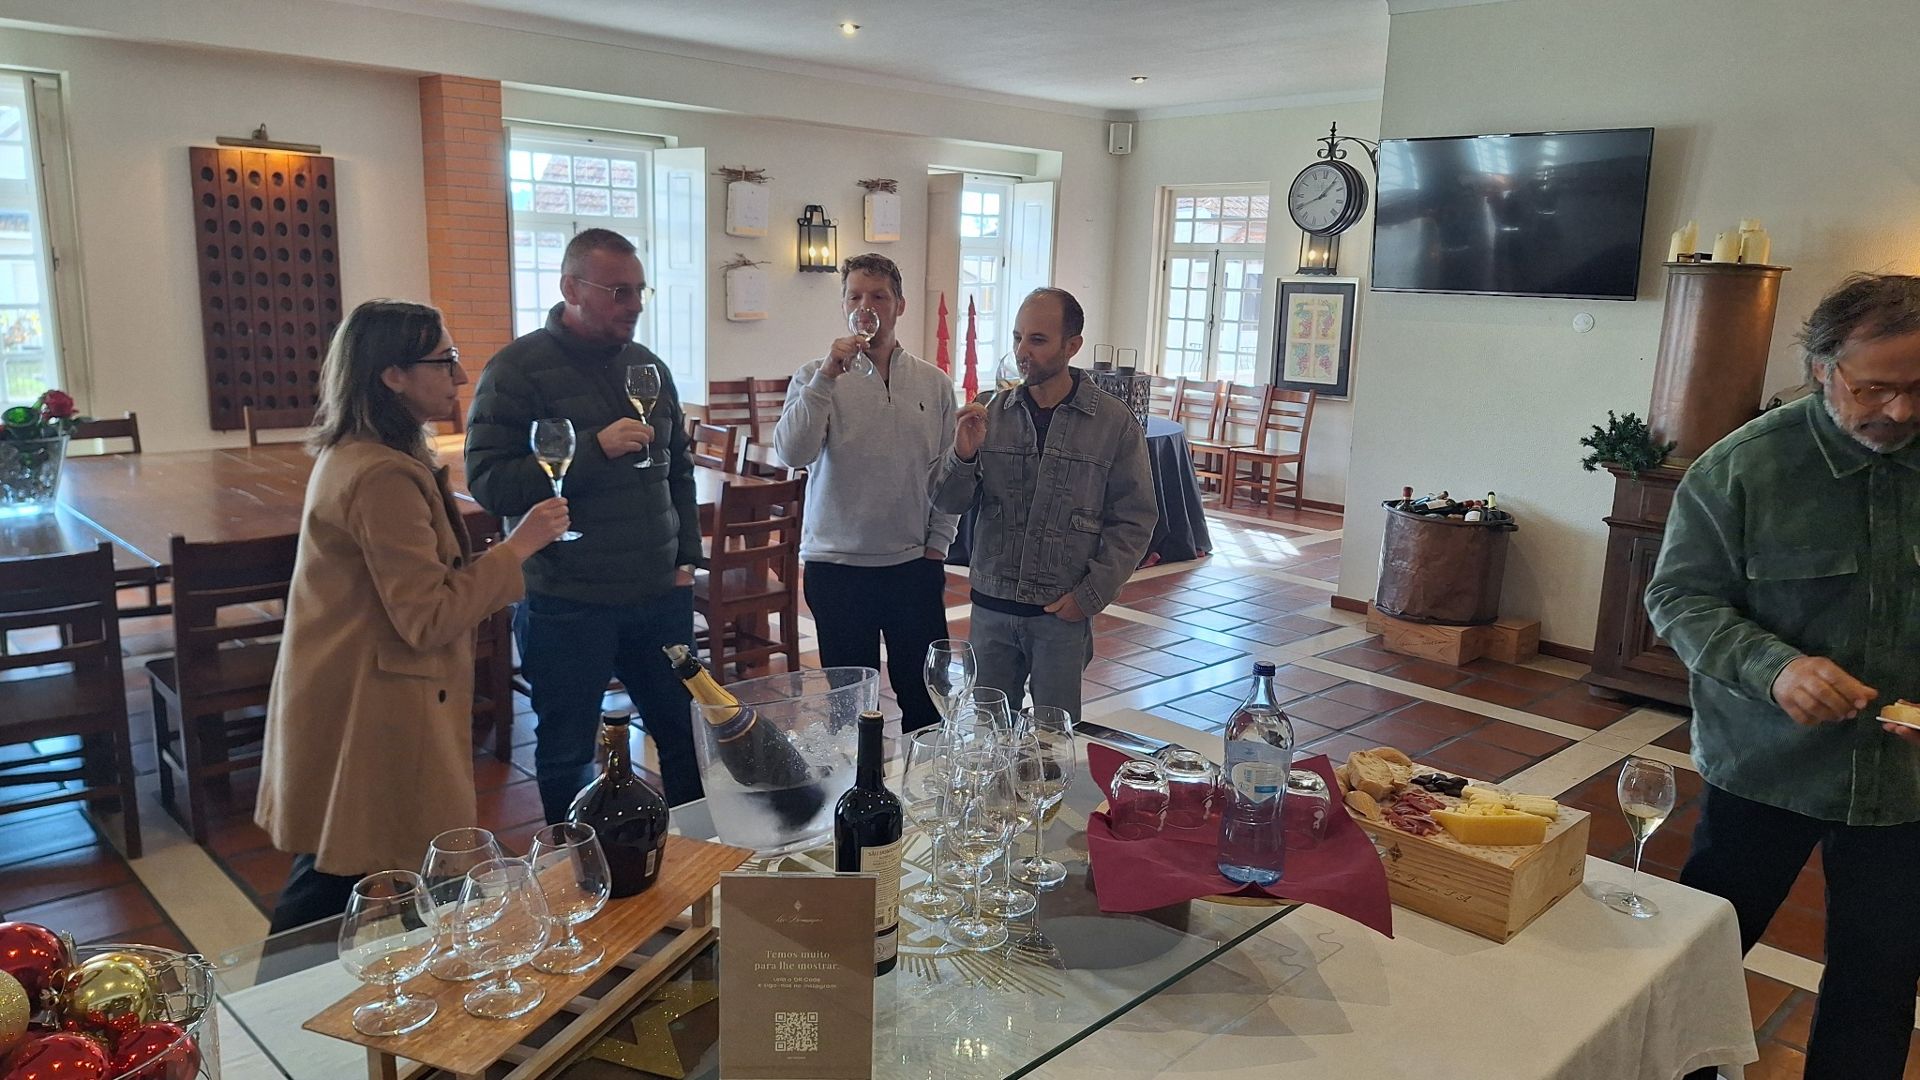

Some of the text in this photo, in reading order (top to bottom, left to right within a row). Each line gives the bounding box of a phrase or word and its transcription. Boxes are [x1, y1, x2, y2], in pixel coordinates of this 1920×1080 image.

[766, 950, 830, 959] Temos muito
[754, 960, 840, 971] para lhe mostrar.
